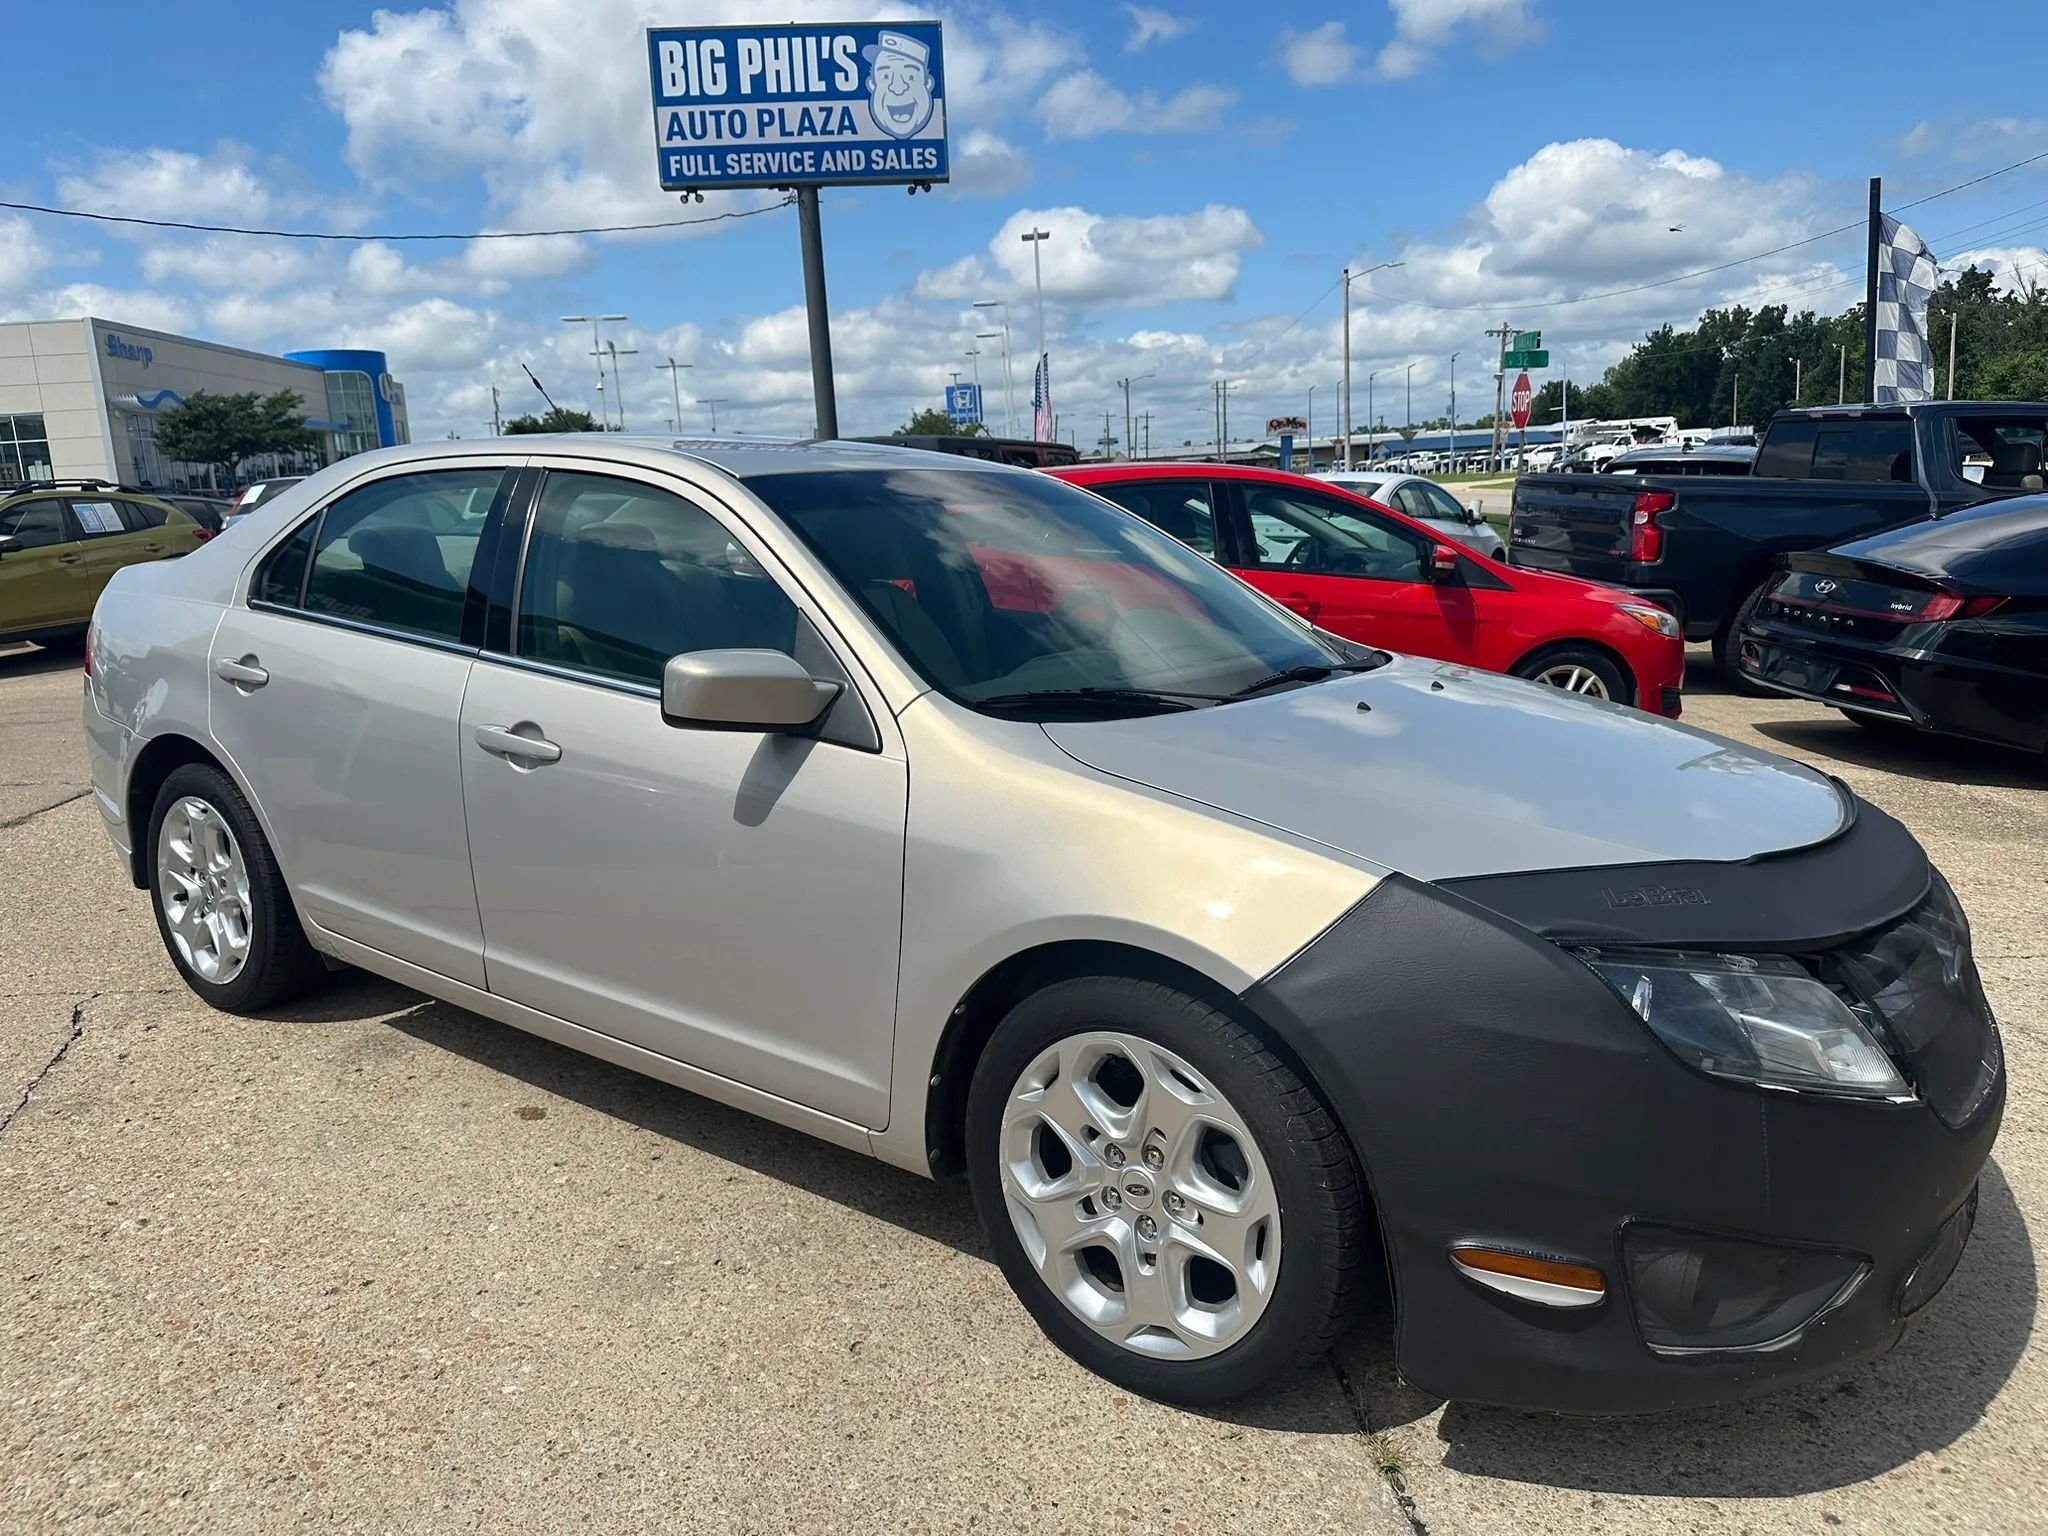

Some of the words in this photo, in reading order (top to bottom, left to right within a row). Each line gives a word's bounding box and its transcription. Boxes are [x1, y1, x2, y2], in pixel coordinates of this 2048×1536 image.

[658, 40, 726, 97] BIG
[737, 35, 859, 94] PHIL'S
[666, 109, 747, 141] AUTO
[756, 106, 859, 138] PLAZA
[669, 154, 721, 177] FULL
[726, 150, 815, 174] SERVICE
[820, 149, 866, 171] AND
[871, 147, 938, 170] SALES
[107, 334, 152, 369] Sharp
[1512, 390, 1530, 412] STOP
[1783, 607, 1854, 626] SONATA
[1890, 602, 1913, 611] hybrid
[1602, 885, 1707, 908] LeBra
